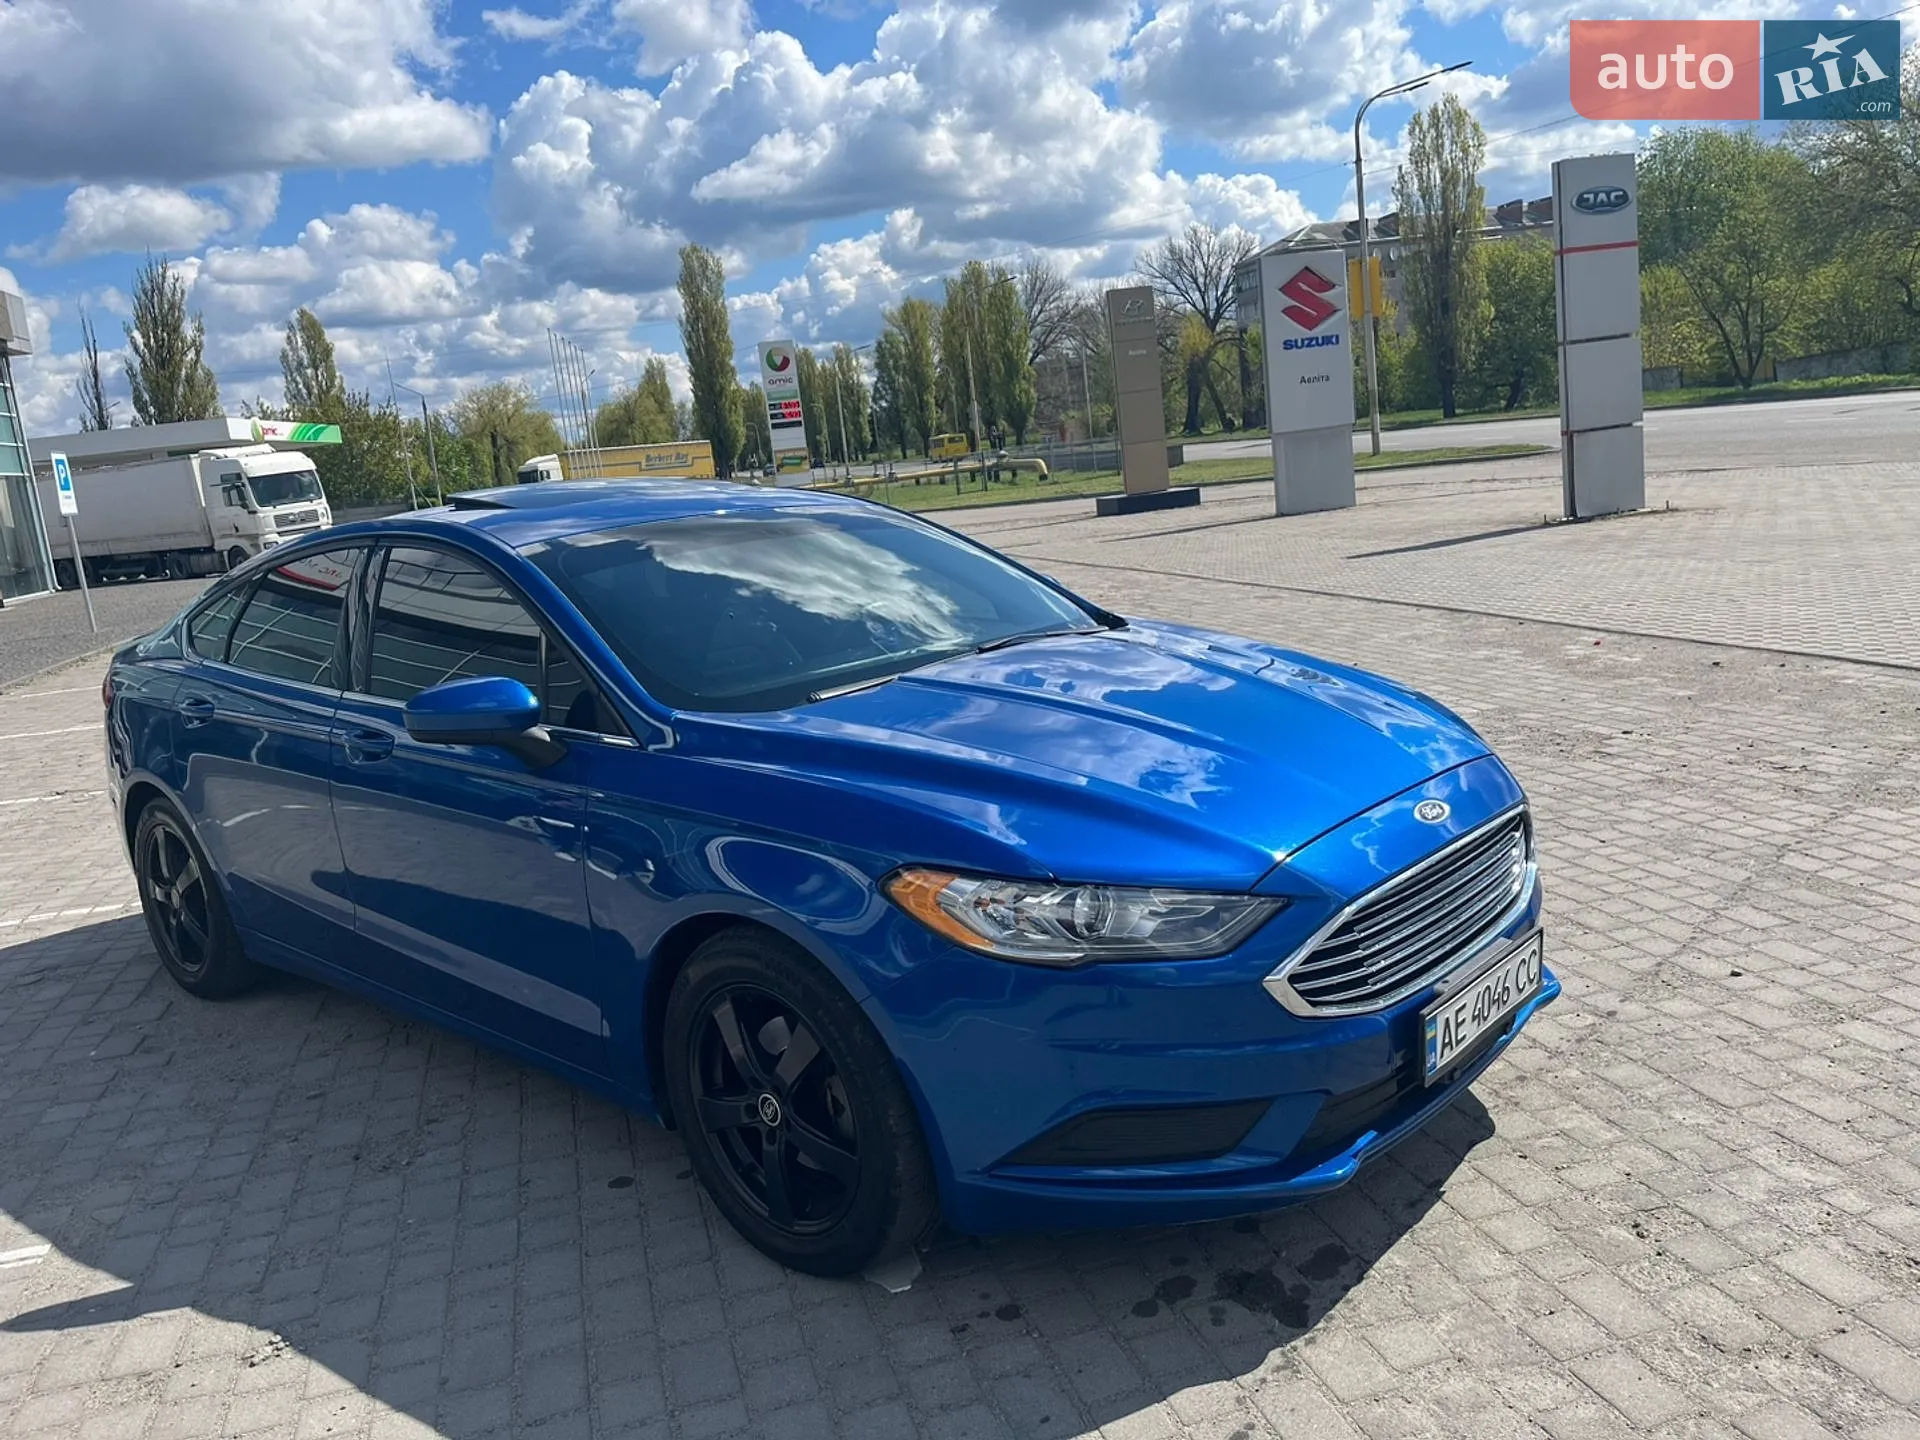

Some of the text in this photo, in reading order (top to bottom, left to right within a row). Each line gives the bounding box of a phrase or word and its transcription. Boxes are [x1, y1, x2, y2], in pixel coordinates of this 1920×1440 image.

[1282, 334, 1340, 350] SUZUKI
[1440, 949, 1537, 1060] AE 4046 CC
